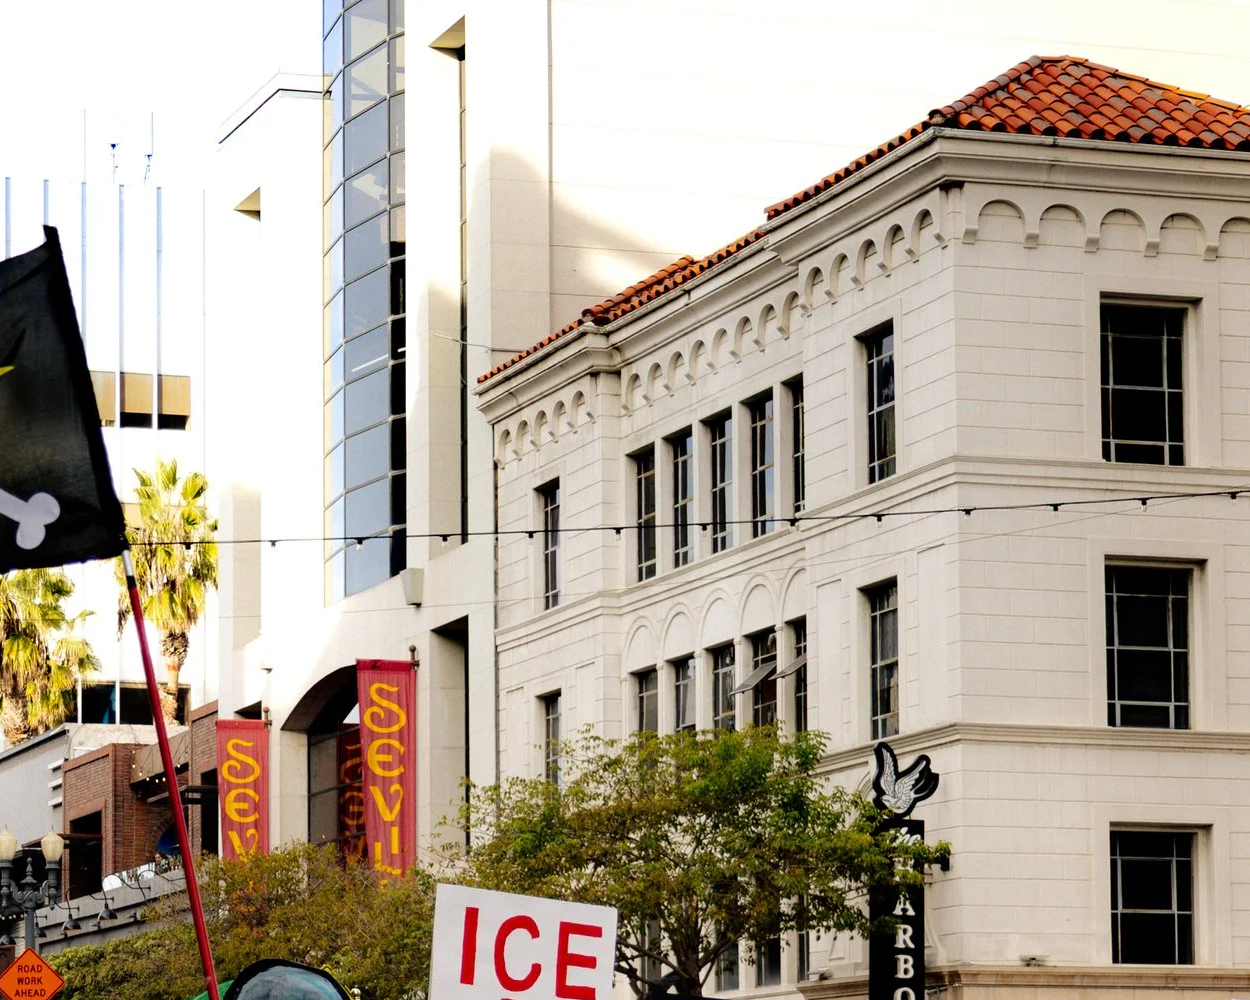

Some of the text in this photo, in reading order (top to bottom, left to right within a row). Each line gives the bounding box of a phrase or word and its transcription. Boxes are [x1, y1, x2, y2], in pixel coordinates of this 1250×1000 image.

[221, 738, 261, 862] SEV
[363, 682, 407, 875] SEVIL
[17, 965, 42, 973] ROAD
[460, 906, 603, 1000] ICE
[14, 989, 46, 997] AHEAD
[17, 977, 43, 985] WORK
